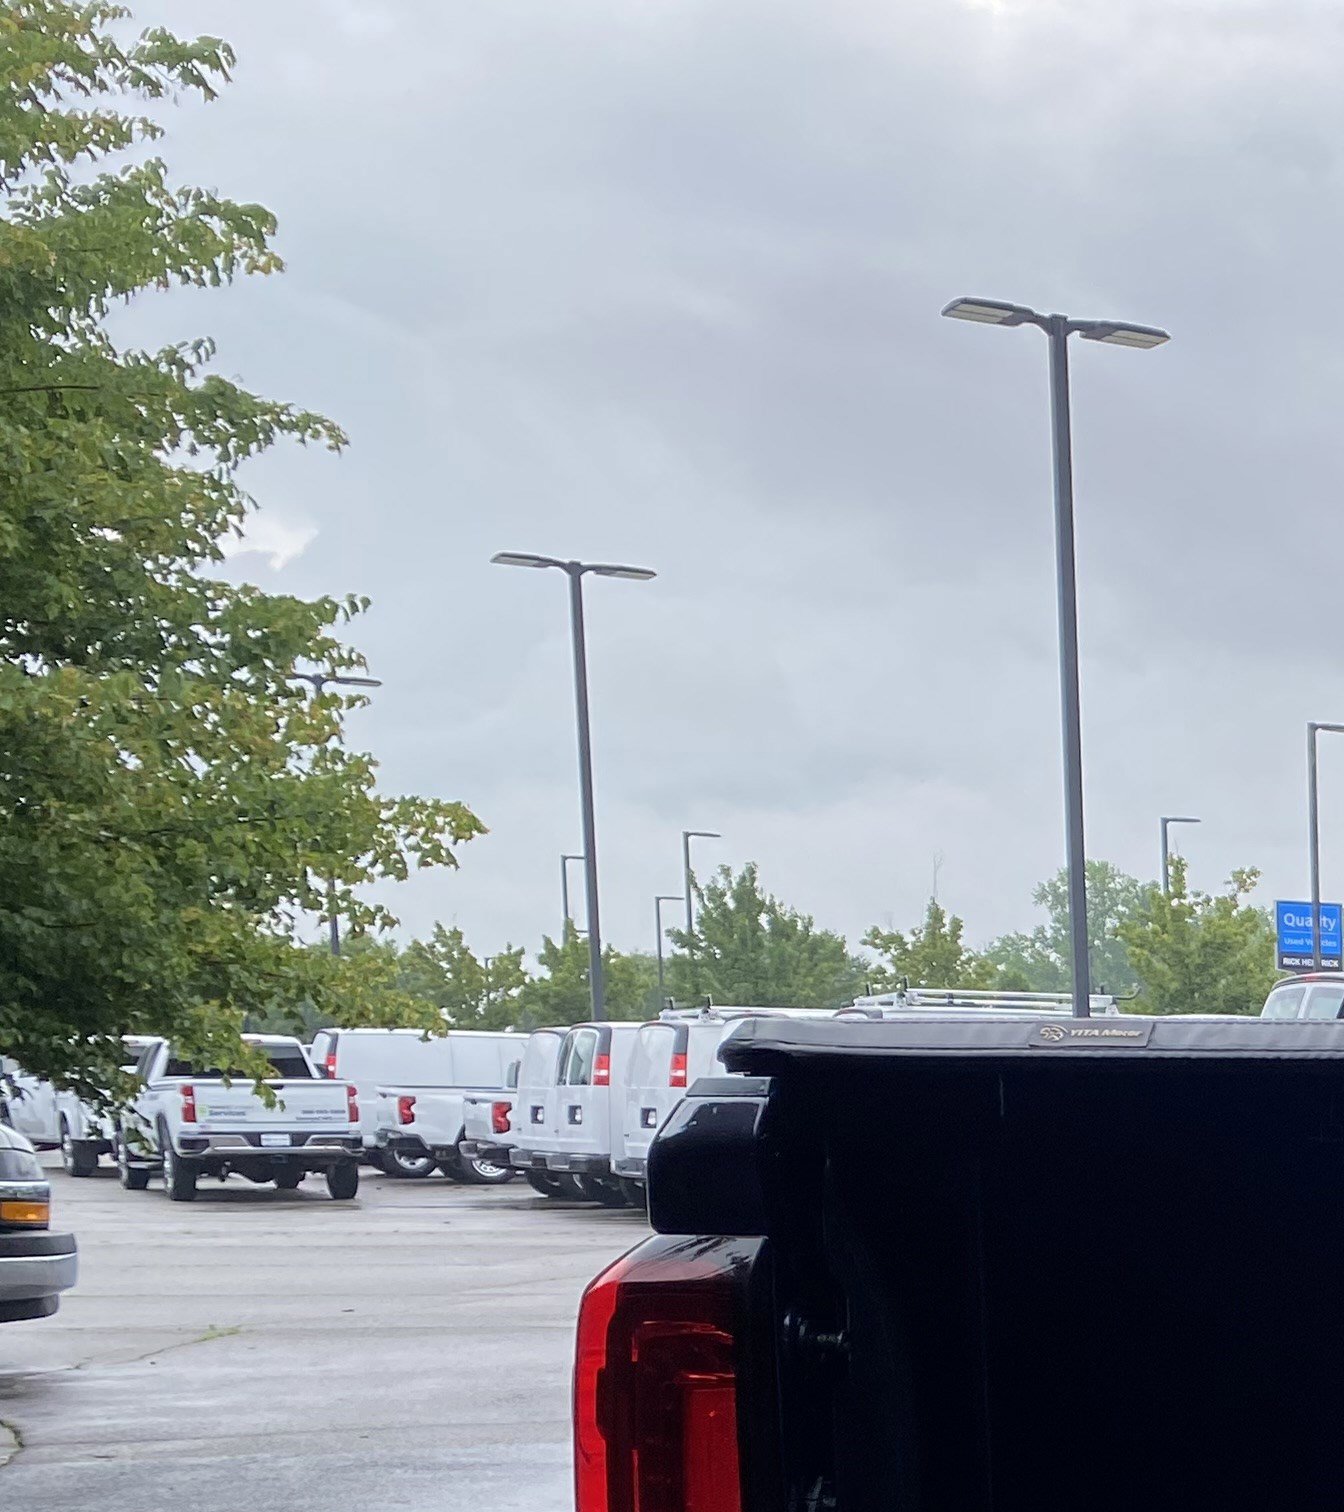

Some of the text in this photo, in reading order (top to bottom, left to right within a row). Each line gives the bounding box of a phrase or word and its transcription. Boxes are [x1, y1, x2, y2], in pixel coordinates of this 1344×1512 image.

[1283, 912, 1337, 932] Quaity
[1283, 937, 1338, 947] Used Vecles
[1282, 957, 1339, 968] RICK HERICK
